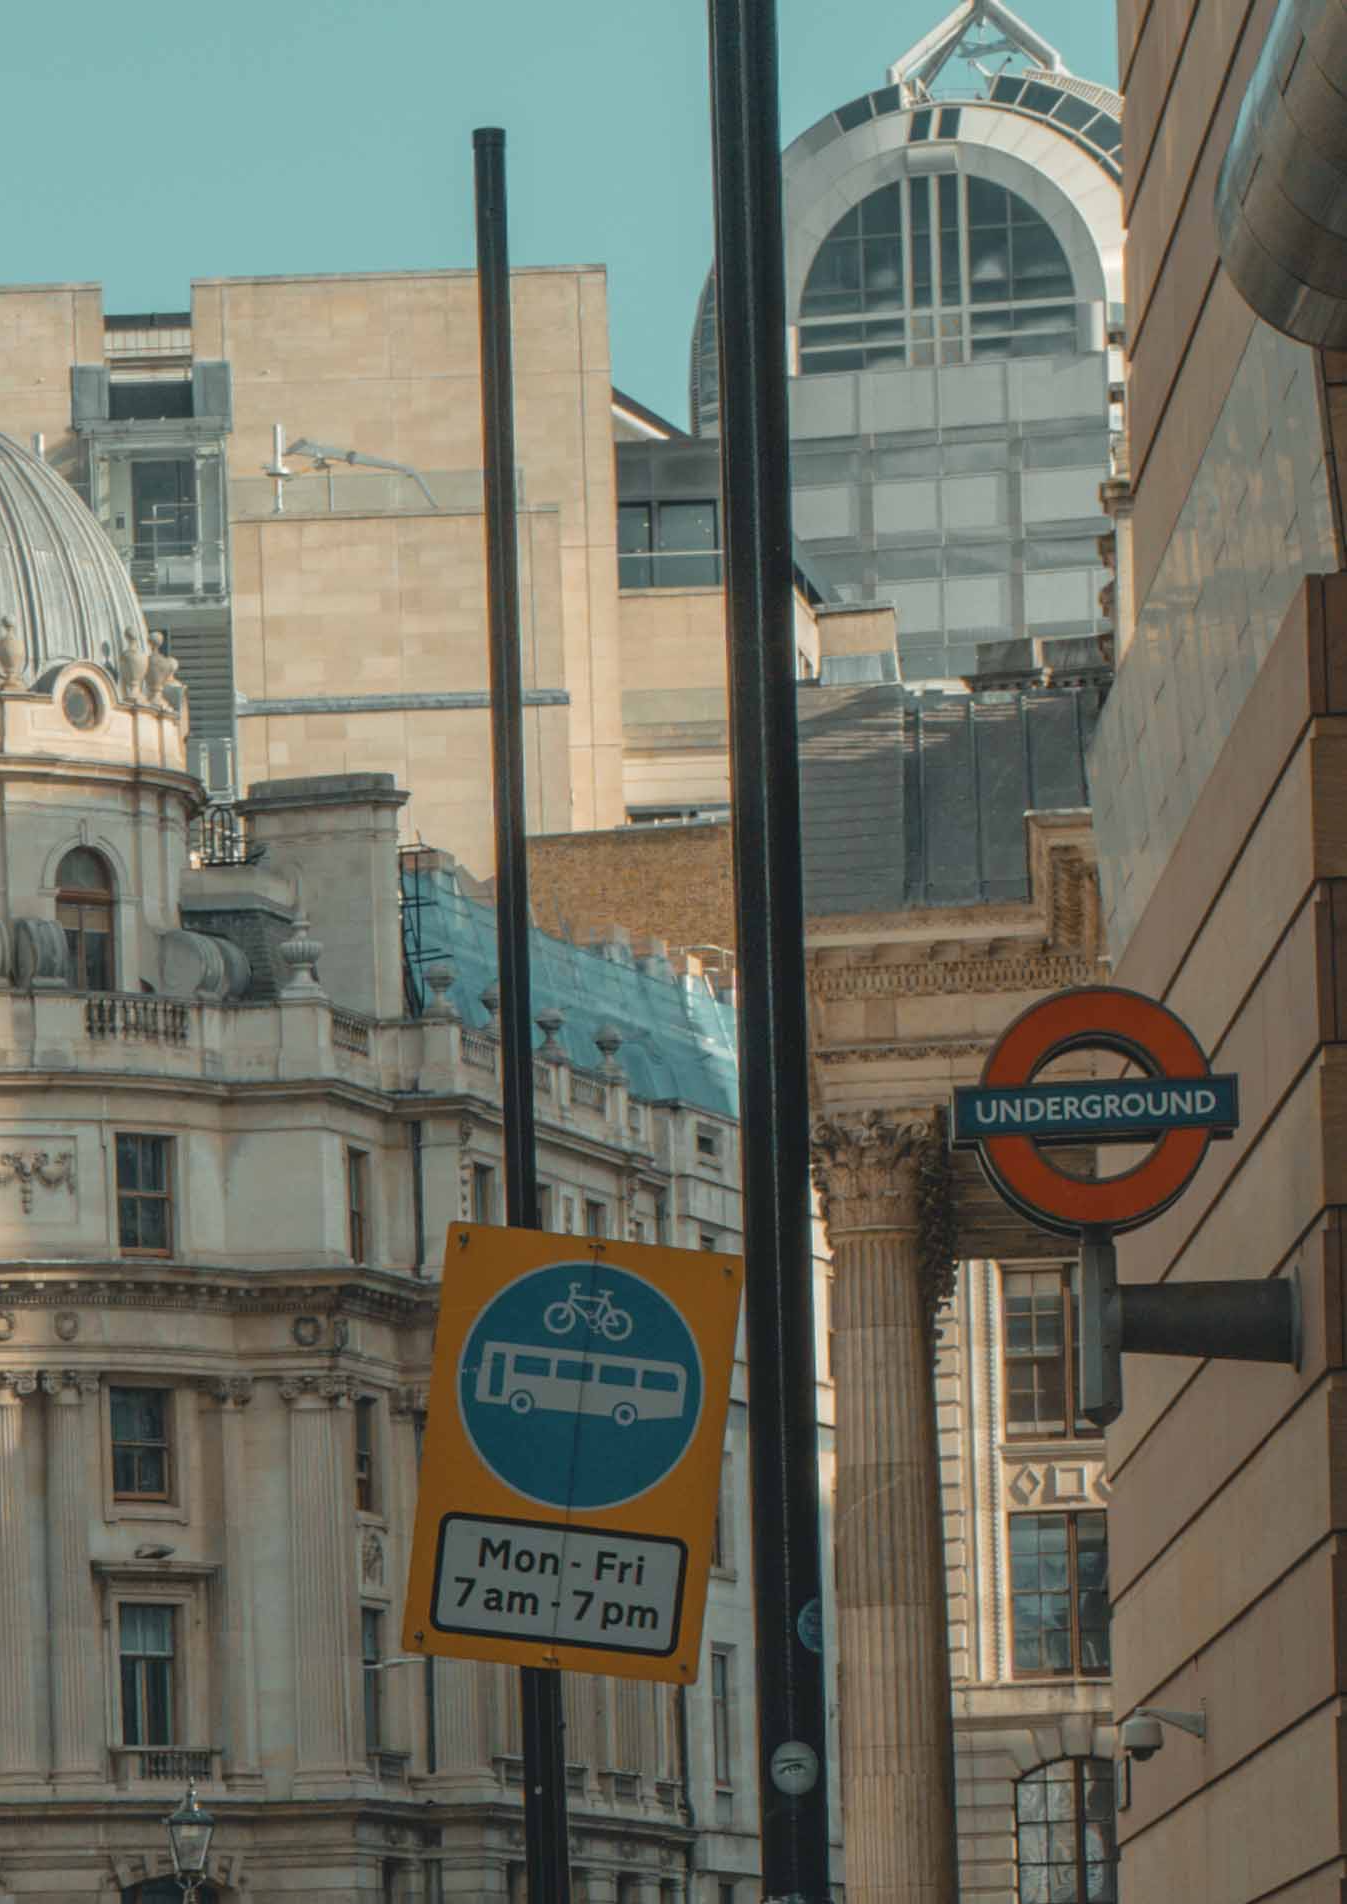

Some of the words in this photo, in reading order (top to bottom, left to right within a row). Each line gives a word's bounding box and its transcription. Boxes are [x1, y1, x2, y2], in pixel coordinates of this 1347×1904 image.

[975, 1089, 1217, 1125] UNDERGROUND
[478, 1536, 559, 1575] Mon
[594, 1550, 646, 1586] Fri
